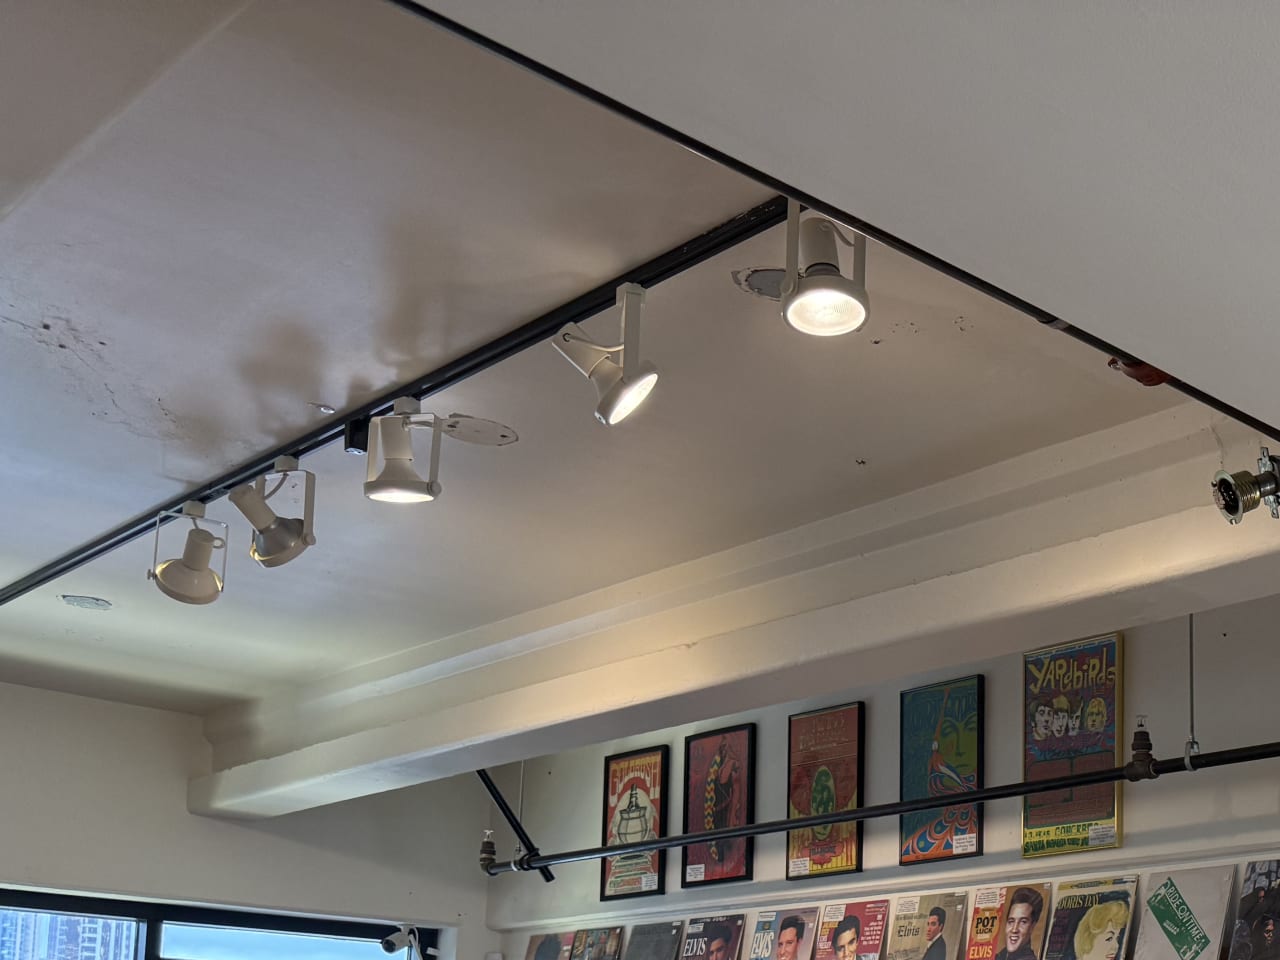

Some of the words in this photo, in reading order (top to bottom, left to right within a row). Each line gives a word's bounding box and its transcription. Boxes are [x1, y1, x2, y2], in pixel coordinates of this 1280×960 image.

[975, 916, 998, 929] POT
[897, 925, 921, 938] Elvis
[976, 927, 993, 935] LUCK
[683, 937, 708, 957] ELVIS
[751, 932, 775, 958] ELVIS
[969, 945, 993, 959] ELVIS
